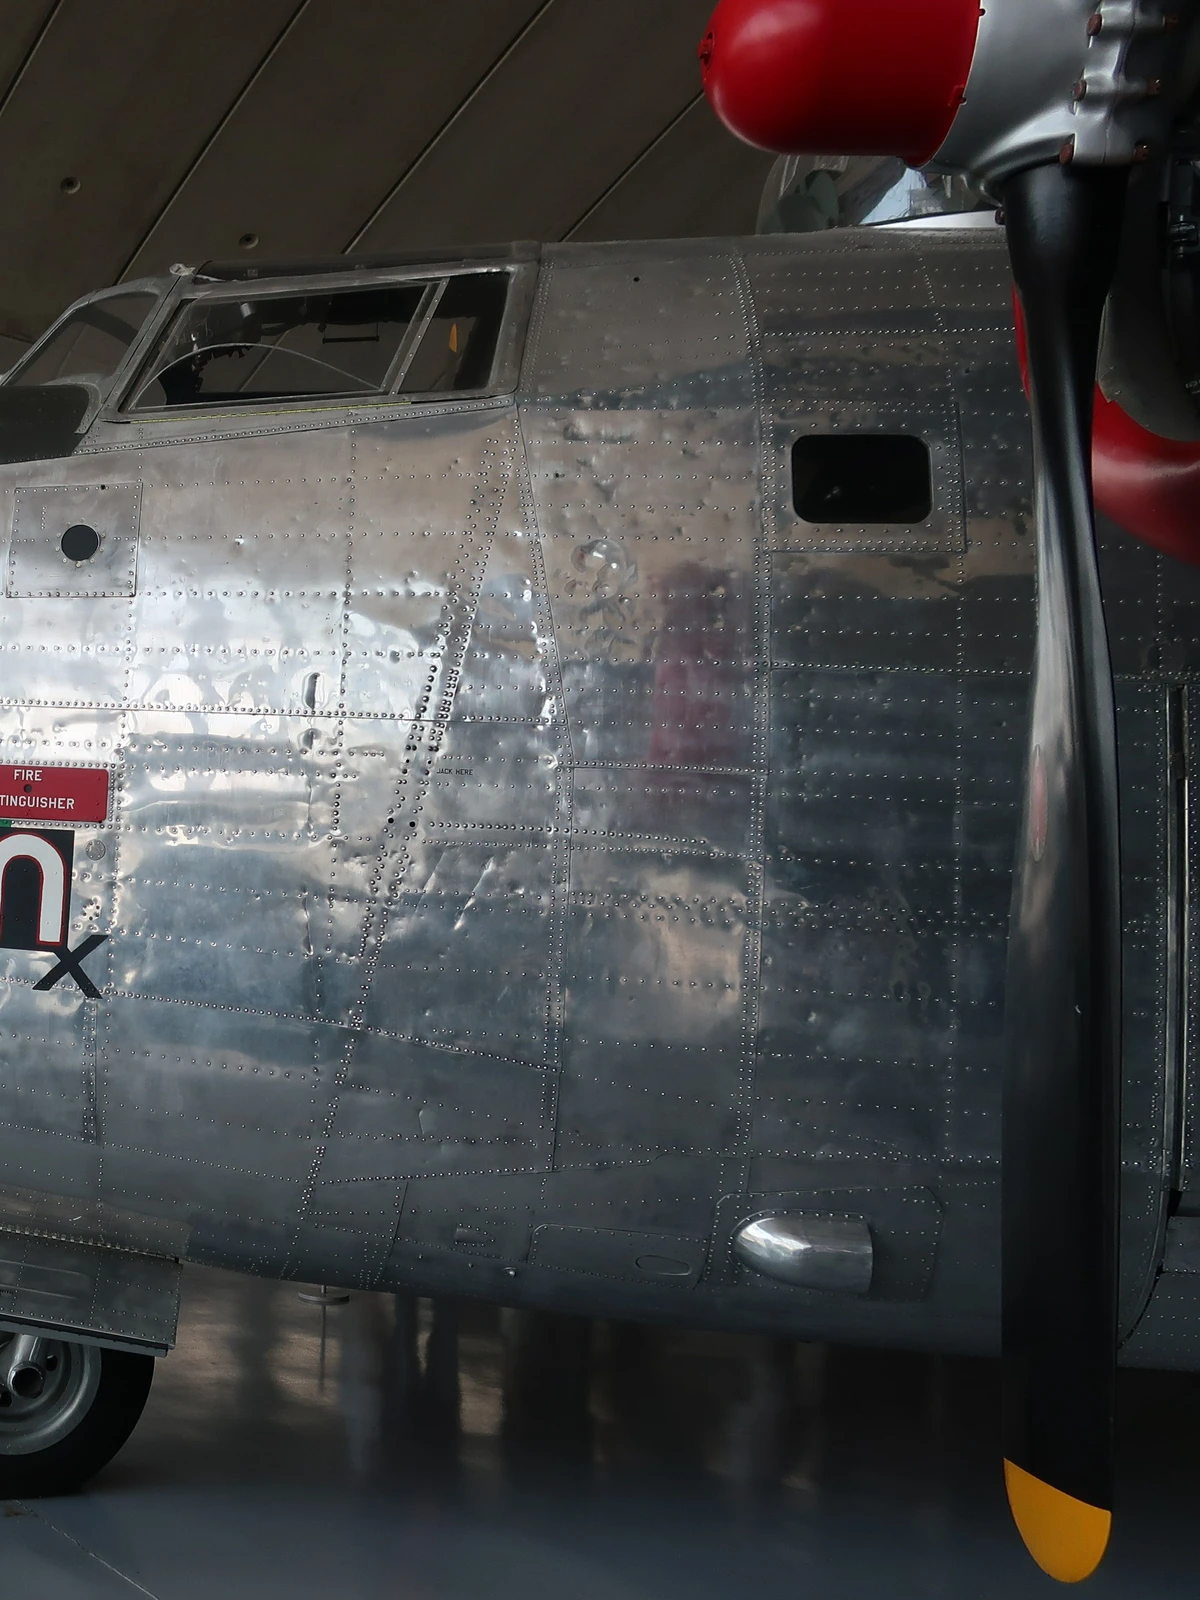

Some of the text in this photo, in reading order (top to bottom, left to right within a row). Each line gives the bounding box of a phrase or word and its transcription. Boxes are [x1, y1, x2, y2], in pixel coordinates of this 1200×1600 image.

[13, 769, 43, 782] FIRE
[436, 767, 474, 776] JACK HERE
